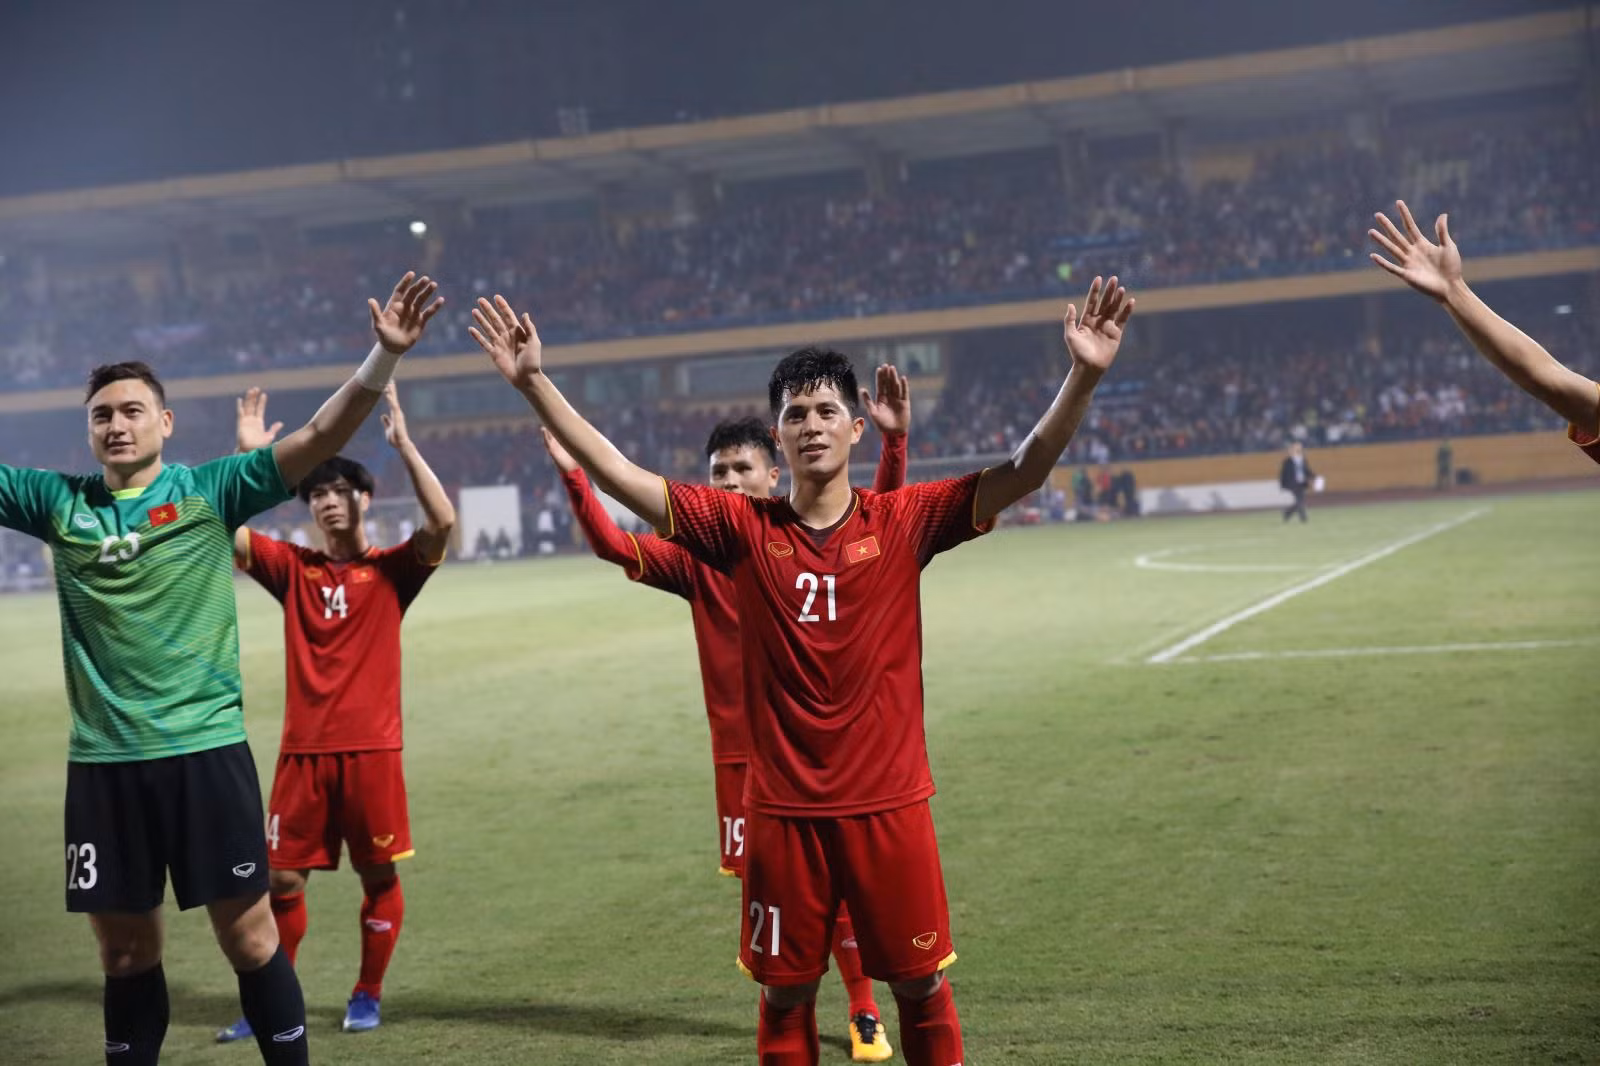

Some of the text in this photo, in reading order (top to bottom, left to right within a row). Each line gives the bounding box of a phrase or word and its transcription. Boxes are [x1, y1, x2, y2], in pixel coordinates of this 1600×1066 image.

[321, 584, 348, 619] 14
[795, 572, 837, 622] 21
[723, 816, 745, 857] 19
[67, 842, 98, 890] 23
[750, 901, 781, 956] 21
